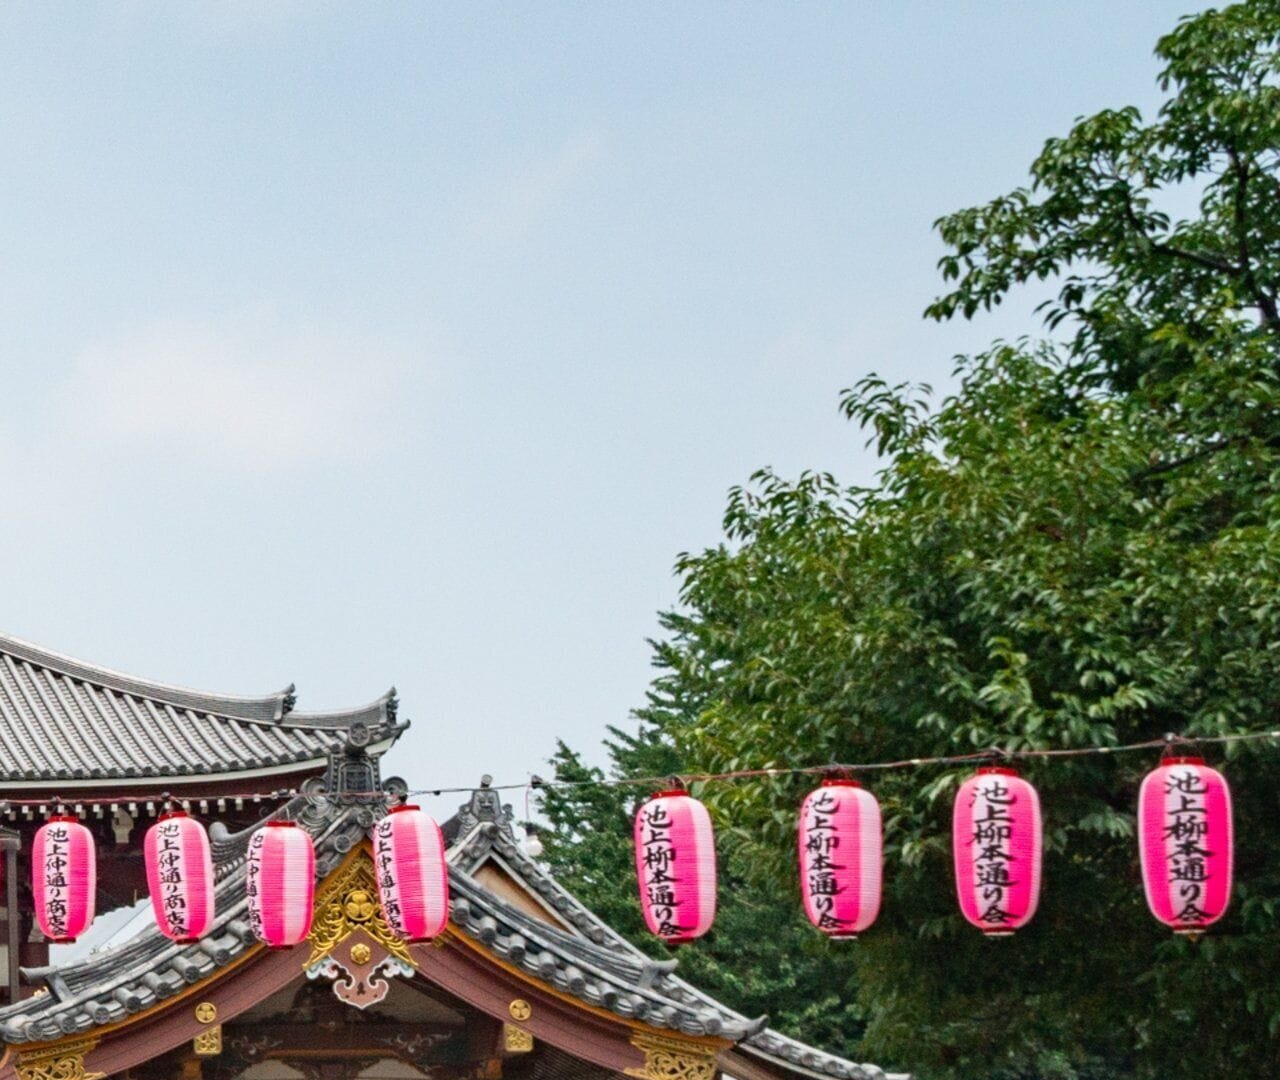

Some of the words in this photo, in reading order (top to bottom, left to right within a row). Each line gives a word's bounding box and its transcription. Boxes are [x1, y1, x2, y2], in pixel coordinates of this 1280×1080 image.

[45, 827, 70, 936] 池上仲通り商店会
[157, 824, 192, 937] 池上仲通り商店会
[640, 805, 697, 937] 池上柳本通り会
[806, 792, 856, 928] 池上柳本通り会
[969, 780, 1020, 924] 池上柳本通り会
[1162, 771, 1216, 924] 池上柳本通り会
